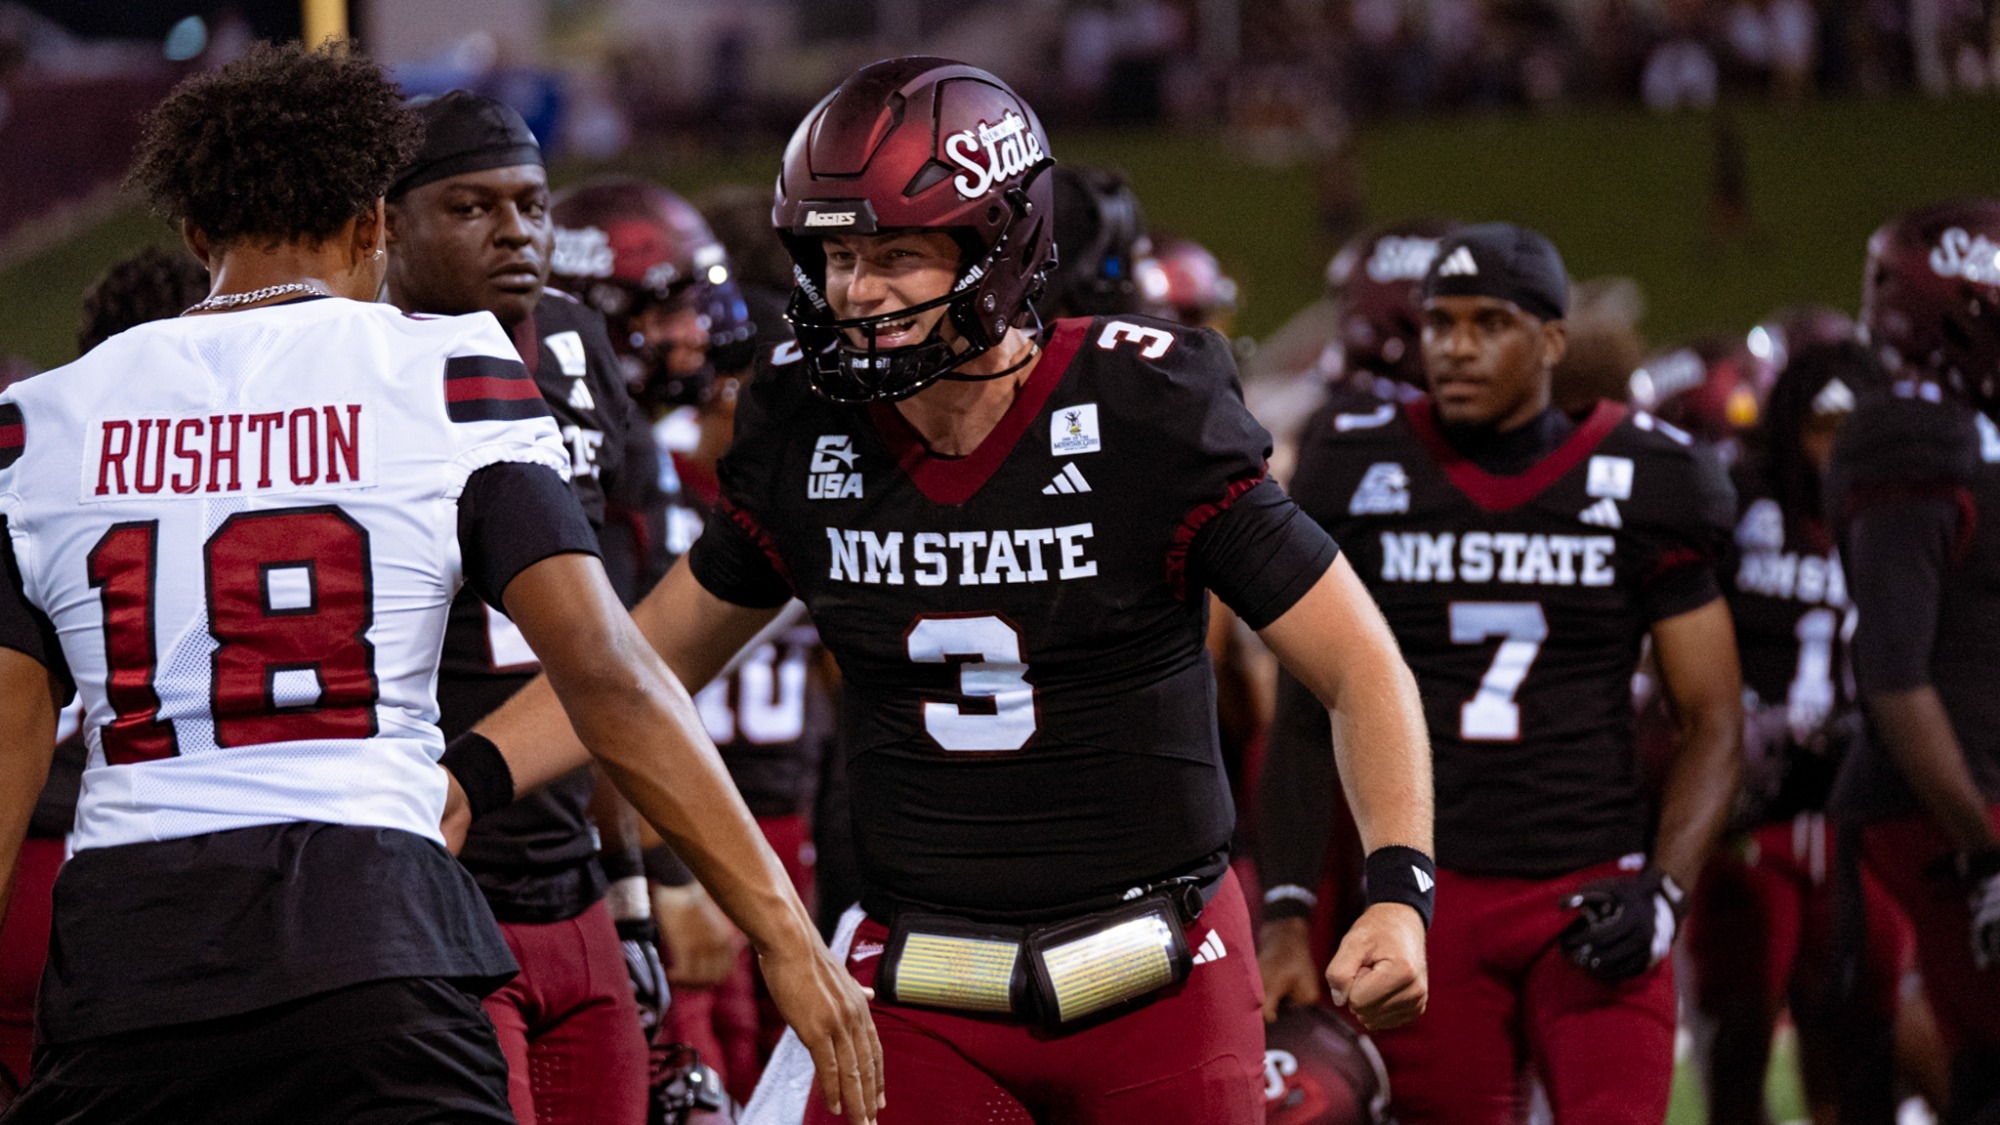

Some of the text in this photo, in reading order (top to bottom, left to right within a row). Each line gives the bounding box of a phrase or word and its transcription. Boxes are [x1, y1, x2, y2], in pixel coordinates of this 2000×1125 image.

[945, 111, 1045, 198] State
[1096, 319, 1177, 361] 3
[95, 403, 363, 496] RUSHTON
[807, 471, 864, 499] USA
[826, 522, 1098, 586] NM STATE
[1380, 531, 1616, 587] NM STATE
[87, 504, 379, 767] 18
[1448, 600, 1549, 742] 7
[905, 611, 1040, 755] 3
